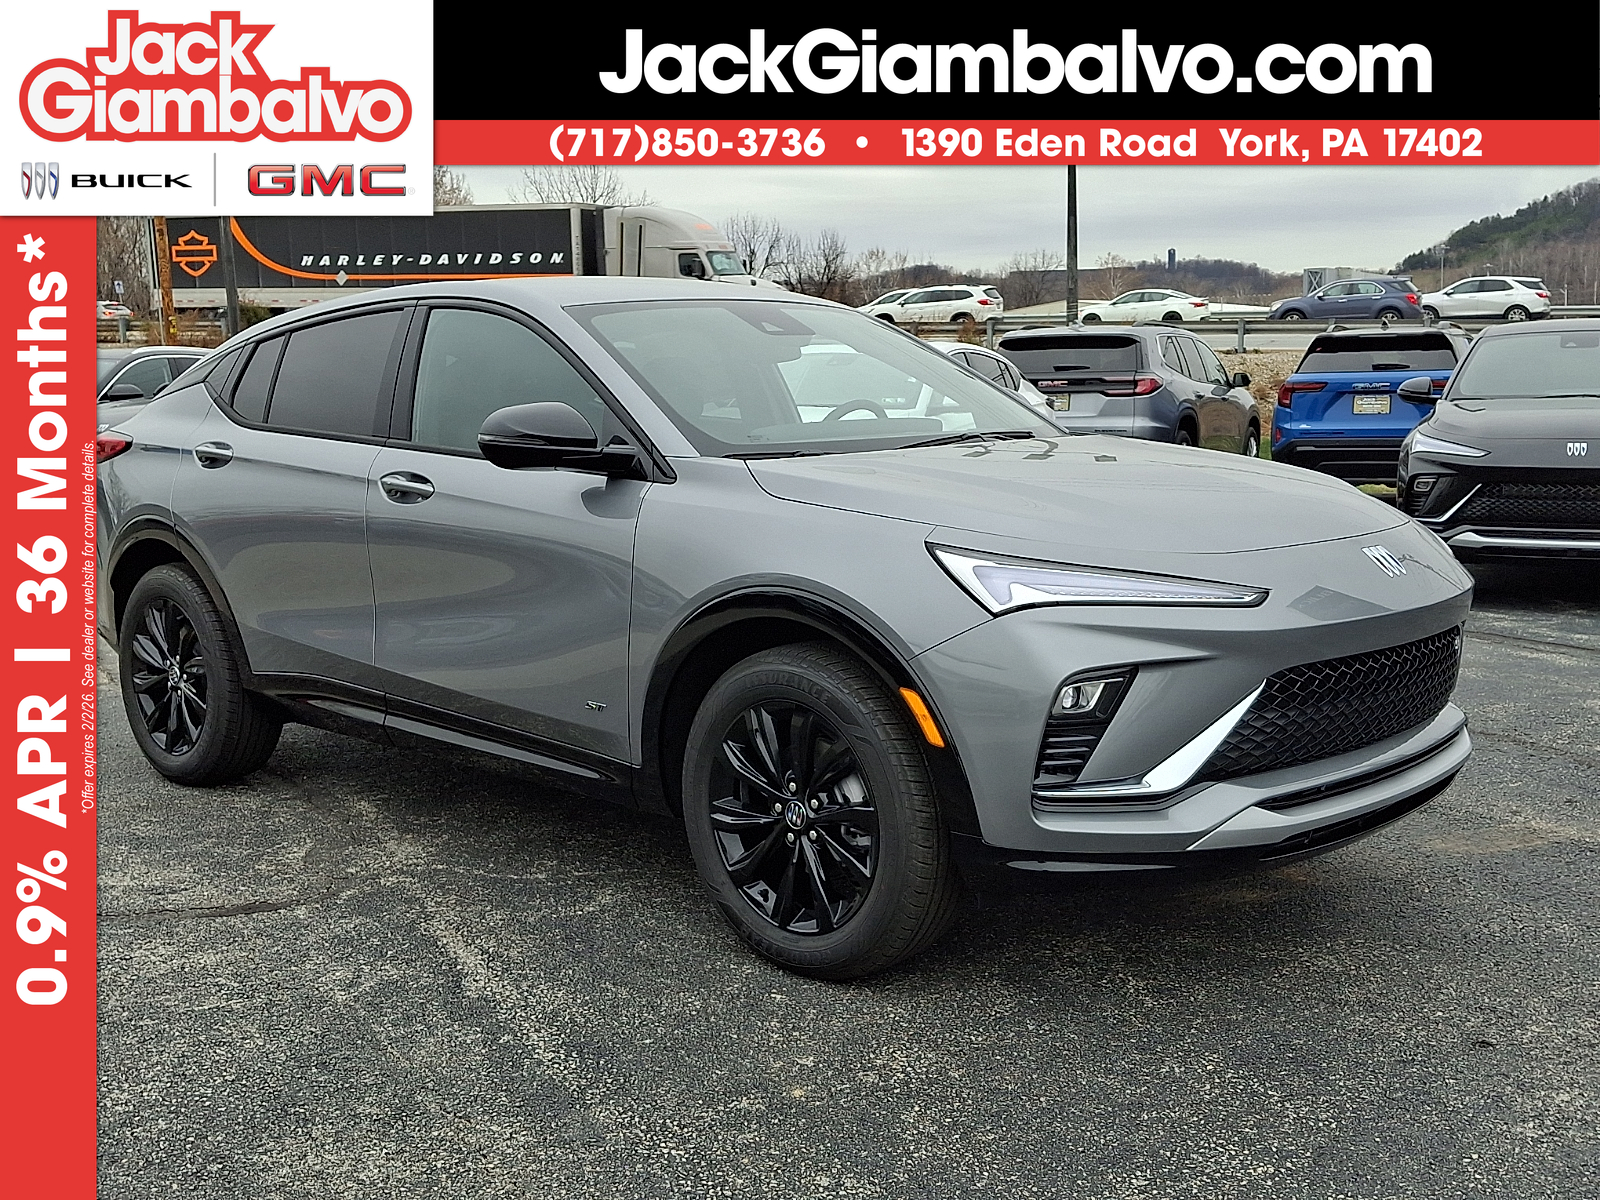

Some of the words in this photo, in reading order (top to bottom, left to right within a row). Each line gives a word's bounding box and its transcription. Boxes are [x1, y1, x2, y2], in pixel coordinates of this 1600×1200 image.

[300, 252, 564, 267] HARLEY-DAVIDSON
[1037, 380, 1069, 388] GMC
[1351, 382, 1391, 390] GMC
